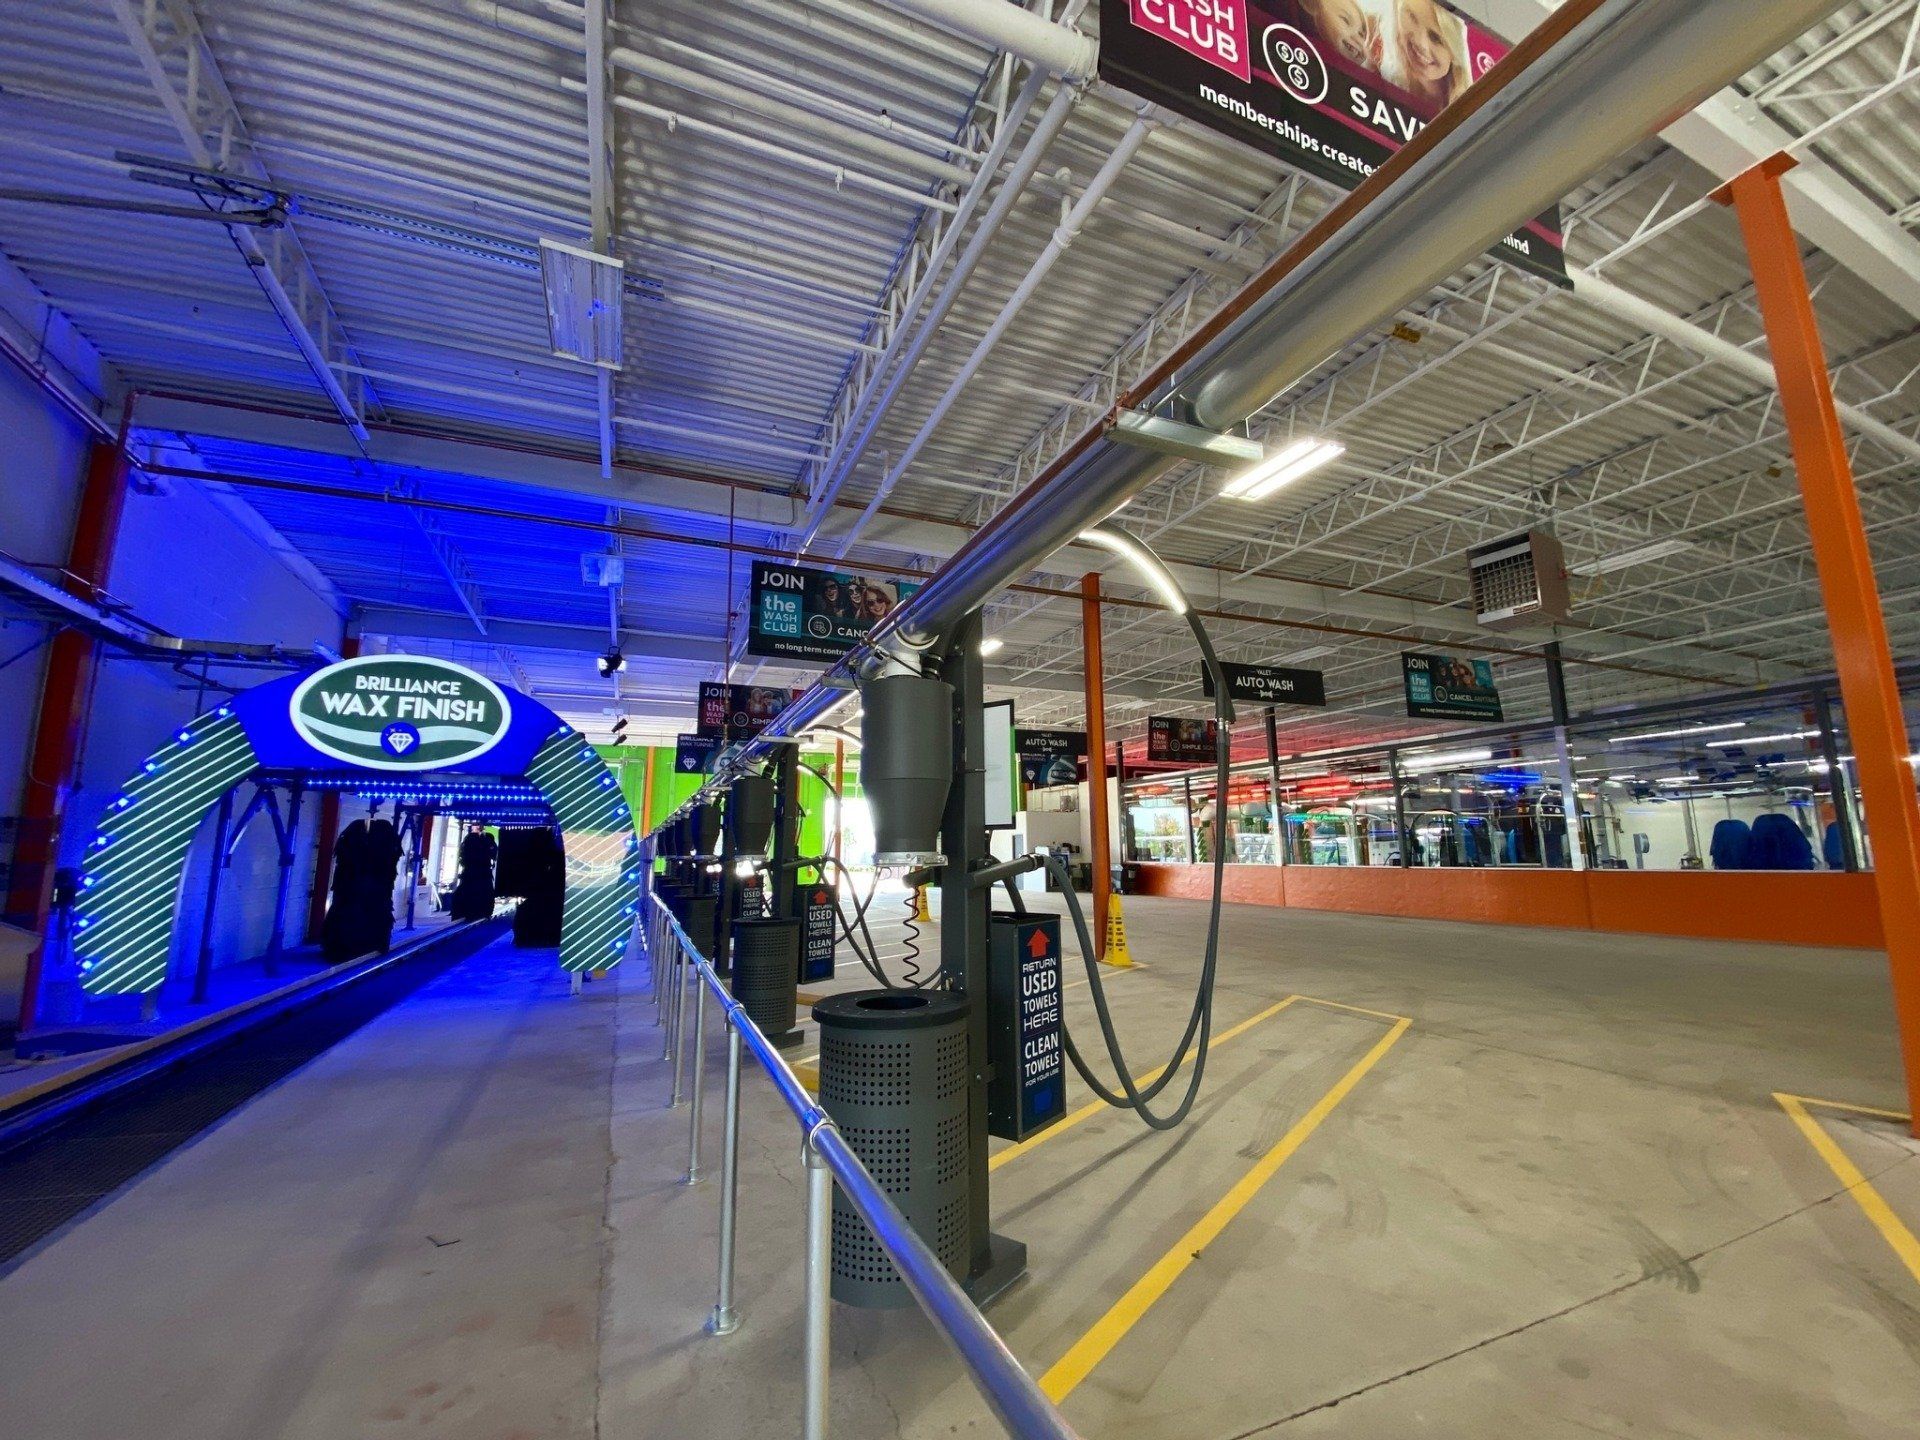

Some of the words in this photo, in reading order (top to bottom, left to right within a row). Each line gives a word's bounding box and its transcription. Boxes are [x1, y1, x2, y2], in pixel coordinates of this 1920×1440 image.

[1184, 0, 1234, 31] SH
[1140, 0, 1239, 63] CLUB
[1200, 82, 1319, 152] memberships
[1350, 86, 1426, 142] SAV
[761, 571, 804, 590] JOIN
[764, 594, 796, 613] the
[763, 611, 797, 623] WASH
[763, 622, 797, 634] CLUB
[786, 643, 803, 652] long
[804, 645, 821, 653] term
[1407, 658, 1428, 669] JOIN
[355, 675, 461, 695] BRILLIANCE
[1236, 676, 1265, 688] AUTO
[1266, 678, 1294, 691] WASH
[1410, 674, 1427, 686] the
[1449, 693, 1473, 701] CANCEL
[321, 691, 388, 717] WAX
[396, 696, 485, 722] FINISH
[1152, 720, 1169, 729] JOIN
[1025, 738, 1047, 746] AUTO
[1048, 739, 1068, 747] WASH
[1153, 731, 1166, 740] the
[809, 910, 832, 921] USED
[809, 920, 832, 929] TOWELS
[808, 928, 832, 937] HERE
[808, 939, 832, 949] CLEAN
[808, 948, 832, 957] TOWELS
[1022, 957, 1056, 973] RETURN
[1022, 969, 1056, 996] USED
[1023, 992, 1058, 1014] TOWELS
[1023, 1008, 1058, 1031] HERE
[1024, 1031, 1059, 1059] CLEAN
[1025, 1051, 1059, 1077] TOWELS
